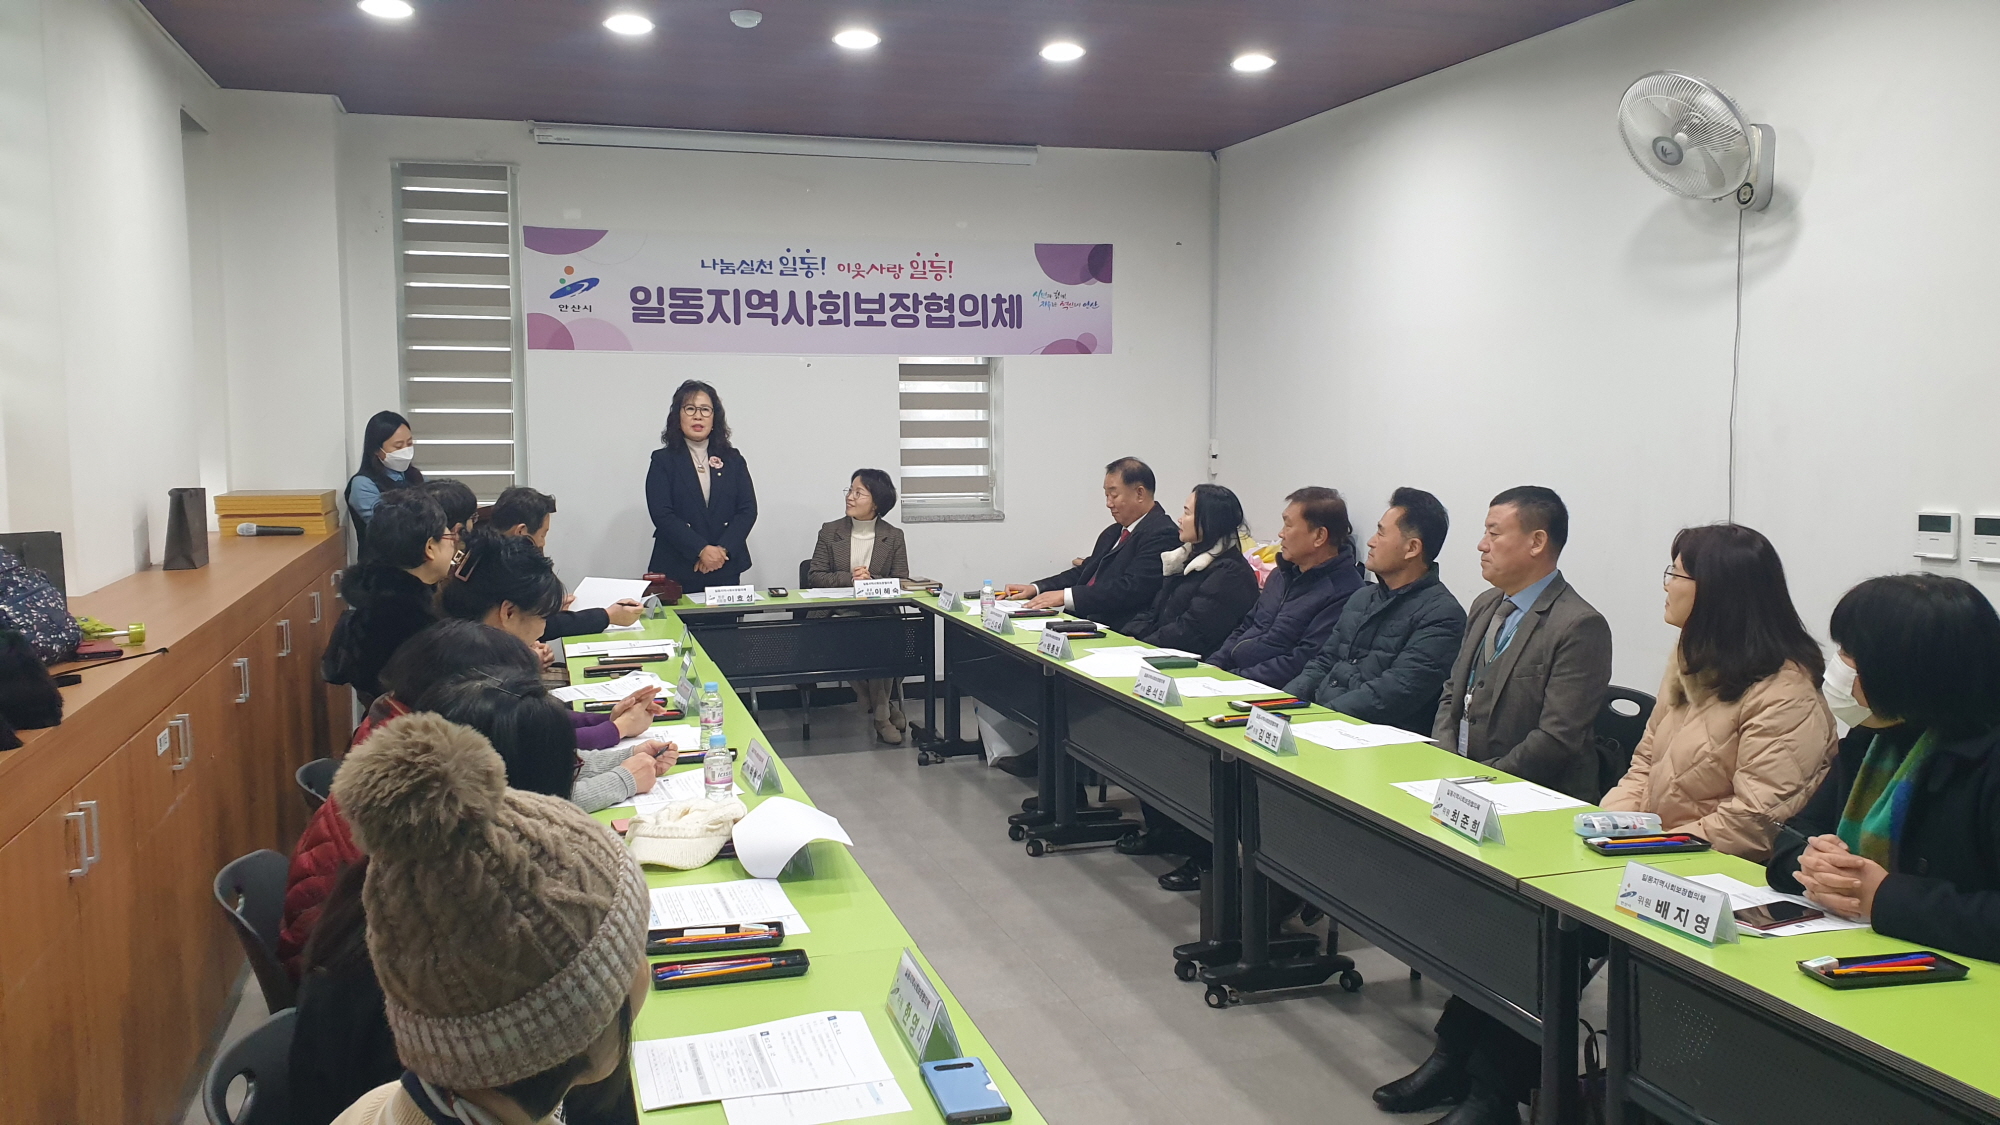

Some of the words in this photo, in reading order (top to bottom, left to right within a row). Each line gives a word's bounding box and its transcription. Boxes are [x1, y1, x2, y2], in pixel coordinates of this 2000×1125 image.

[700, 258, 774, 275] 나눔실천
[778, 247, 827, 279] 일동!
[837, 262, 905, 280] 이웃사랑
[909, 251, 954, 282] 일등!
[558, 304, 592, 313] 안산시
[629, 285, 1023, 330] 일동지역사회보장협의체
[727, 594, 753, 603] 이효성
[1450, 808, 1481, 836] 최준희
[1641, 873, 1707, 904] 일동지역사회보장협의체
[1654, 899, 1710, 934] 배지영
